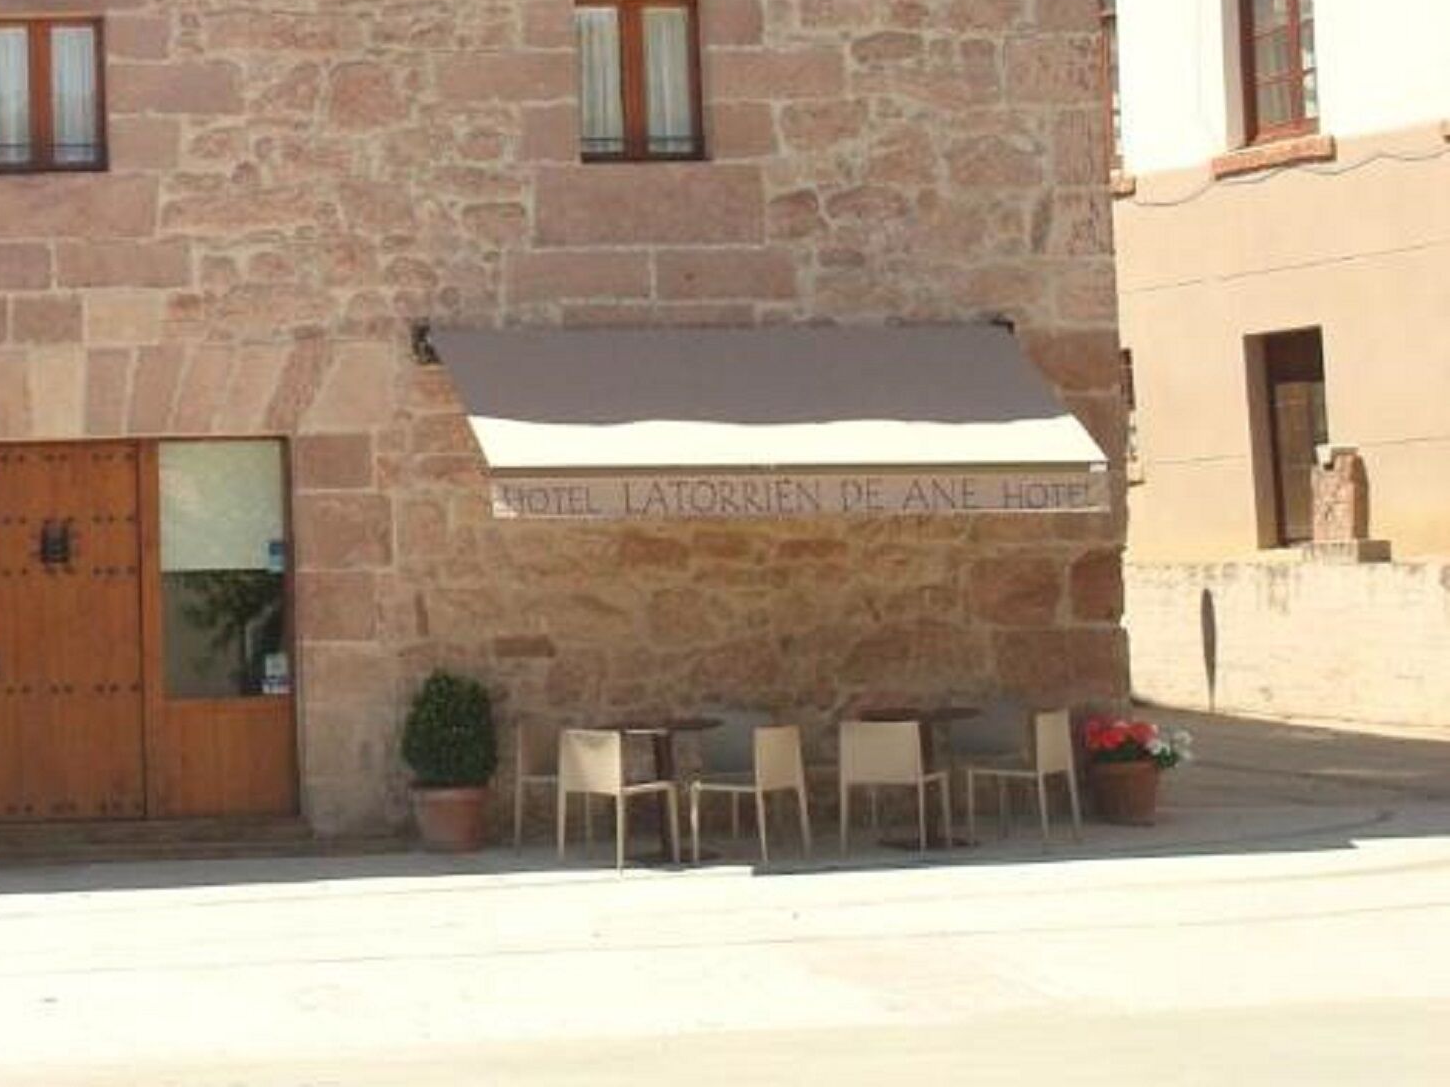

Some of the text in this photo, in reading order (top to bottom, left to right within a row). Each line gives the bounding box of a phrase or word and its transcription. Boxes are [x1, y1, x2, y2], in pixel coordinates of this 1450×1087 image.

[503, 485, 602, 514] HOTEL
[839, 476, 884, 512] DE
[903, 477, 978, 511] ANE
[1002, 479, 1099, 510] HOTEL
